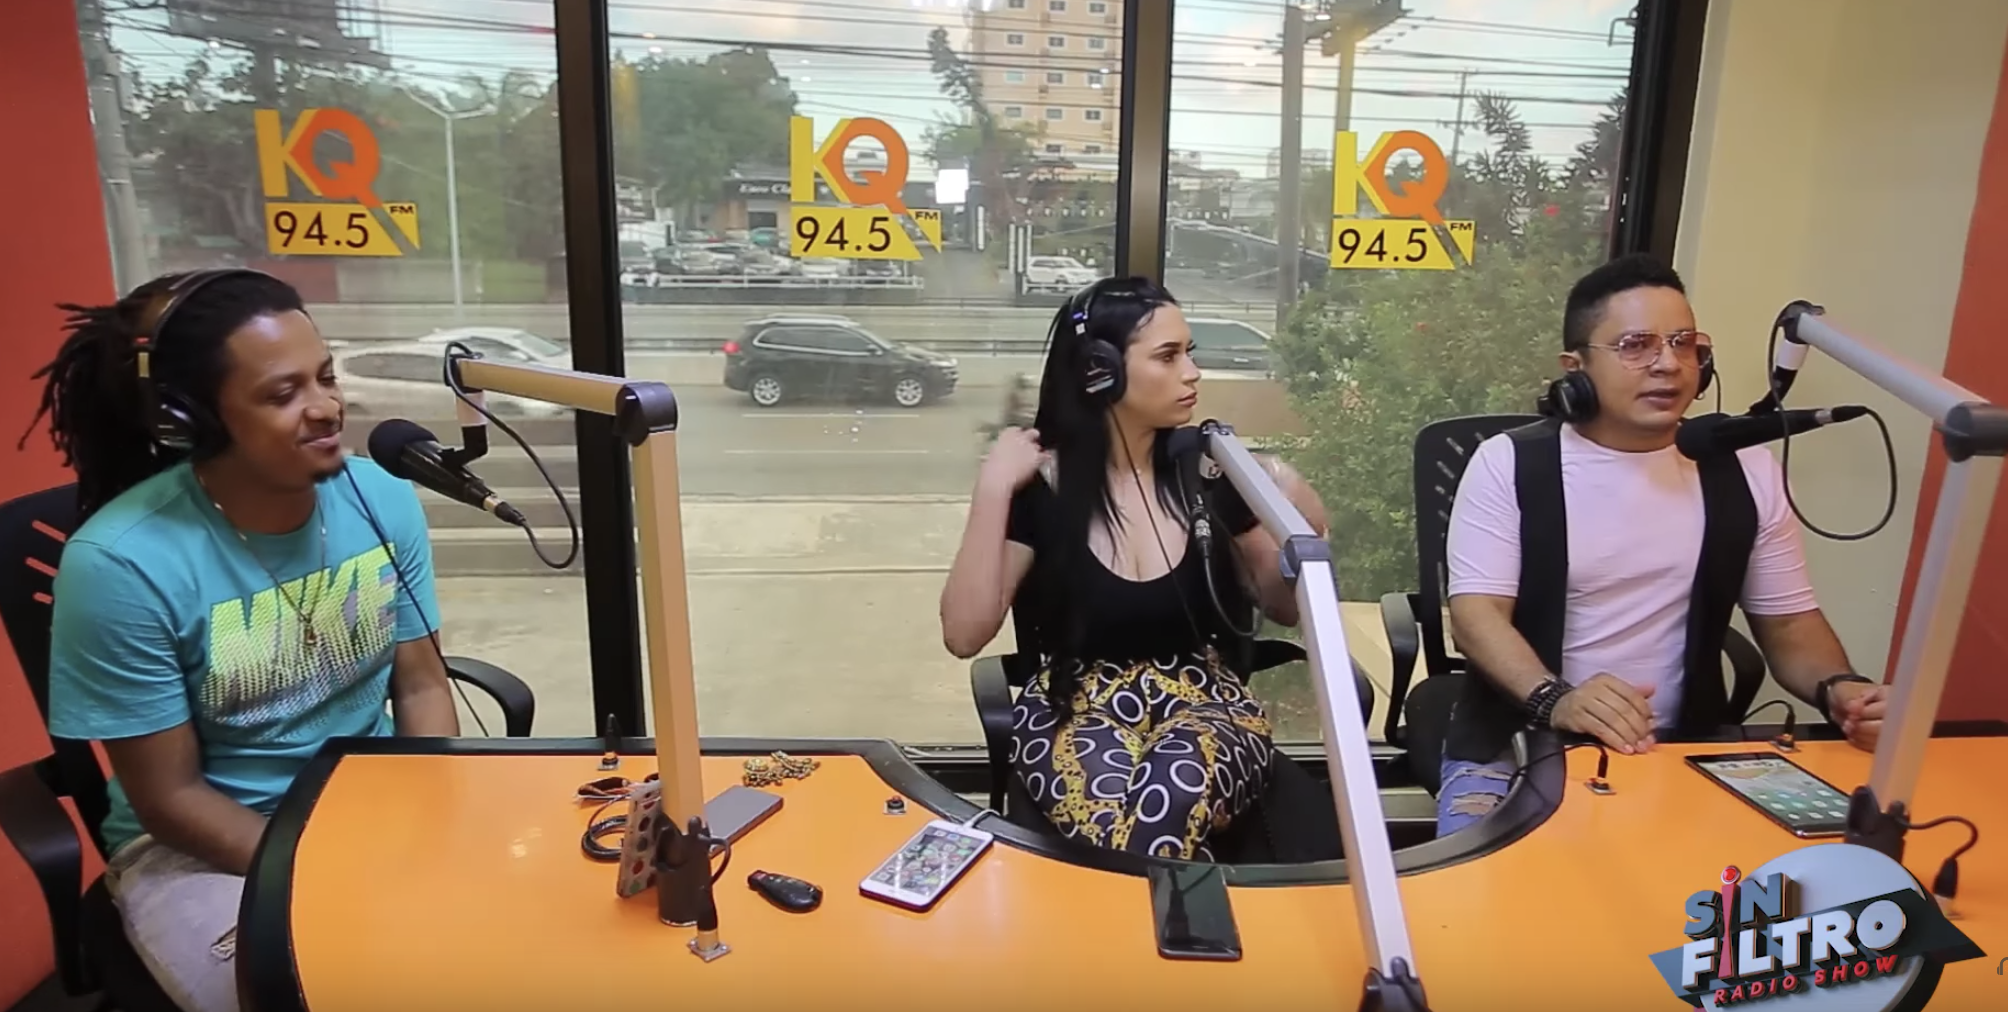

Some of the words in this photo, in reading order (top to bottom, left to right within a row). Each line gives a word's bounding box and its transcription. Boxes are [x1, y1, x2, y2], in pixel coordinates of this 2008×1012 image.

[254, 107, 384, 208] KQ
[790, 116, 909, 214] KQ
[1333, 130, 1448, 226] KQ
[274, 211, 369, 248] 94.5
[389, 205, 414, 214] FM
[796, 216, 891, 252] 94.5
[915, 211, 938, 220] FM
[1338, 228, 1427, 263] 94.5
[1450, 222, 1472, 231] FM
